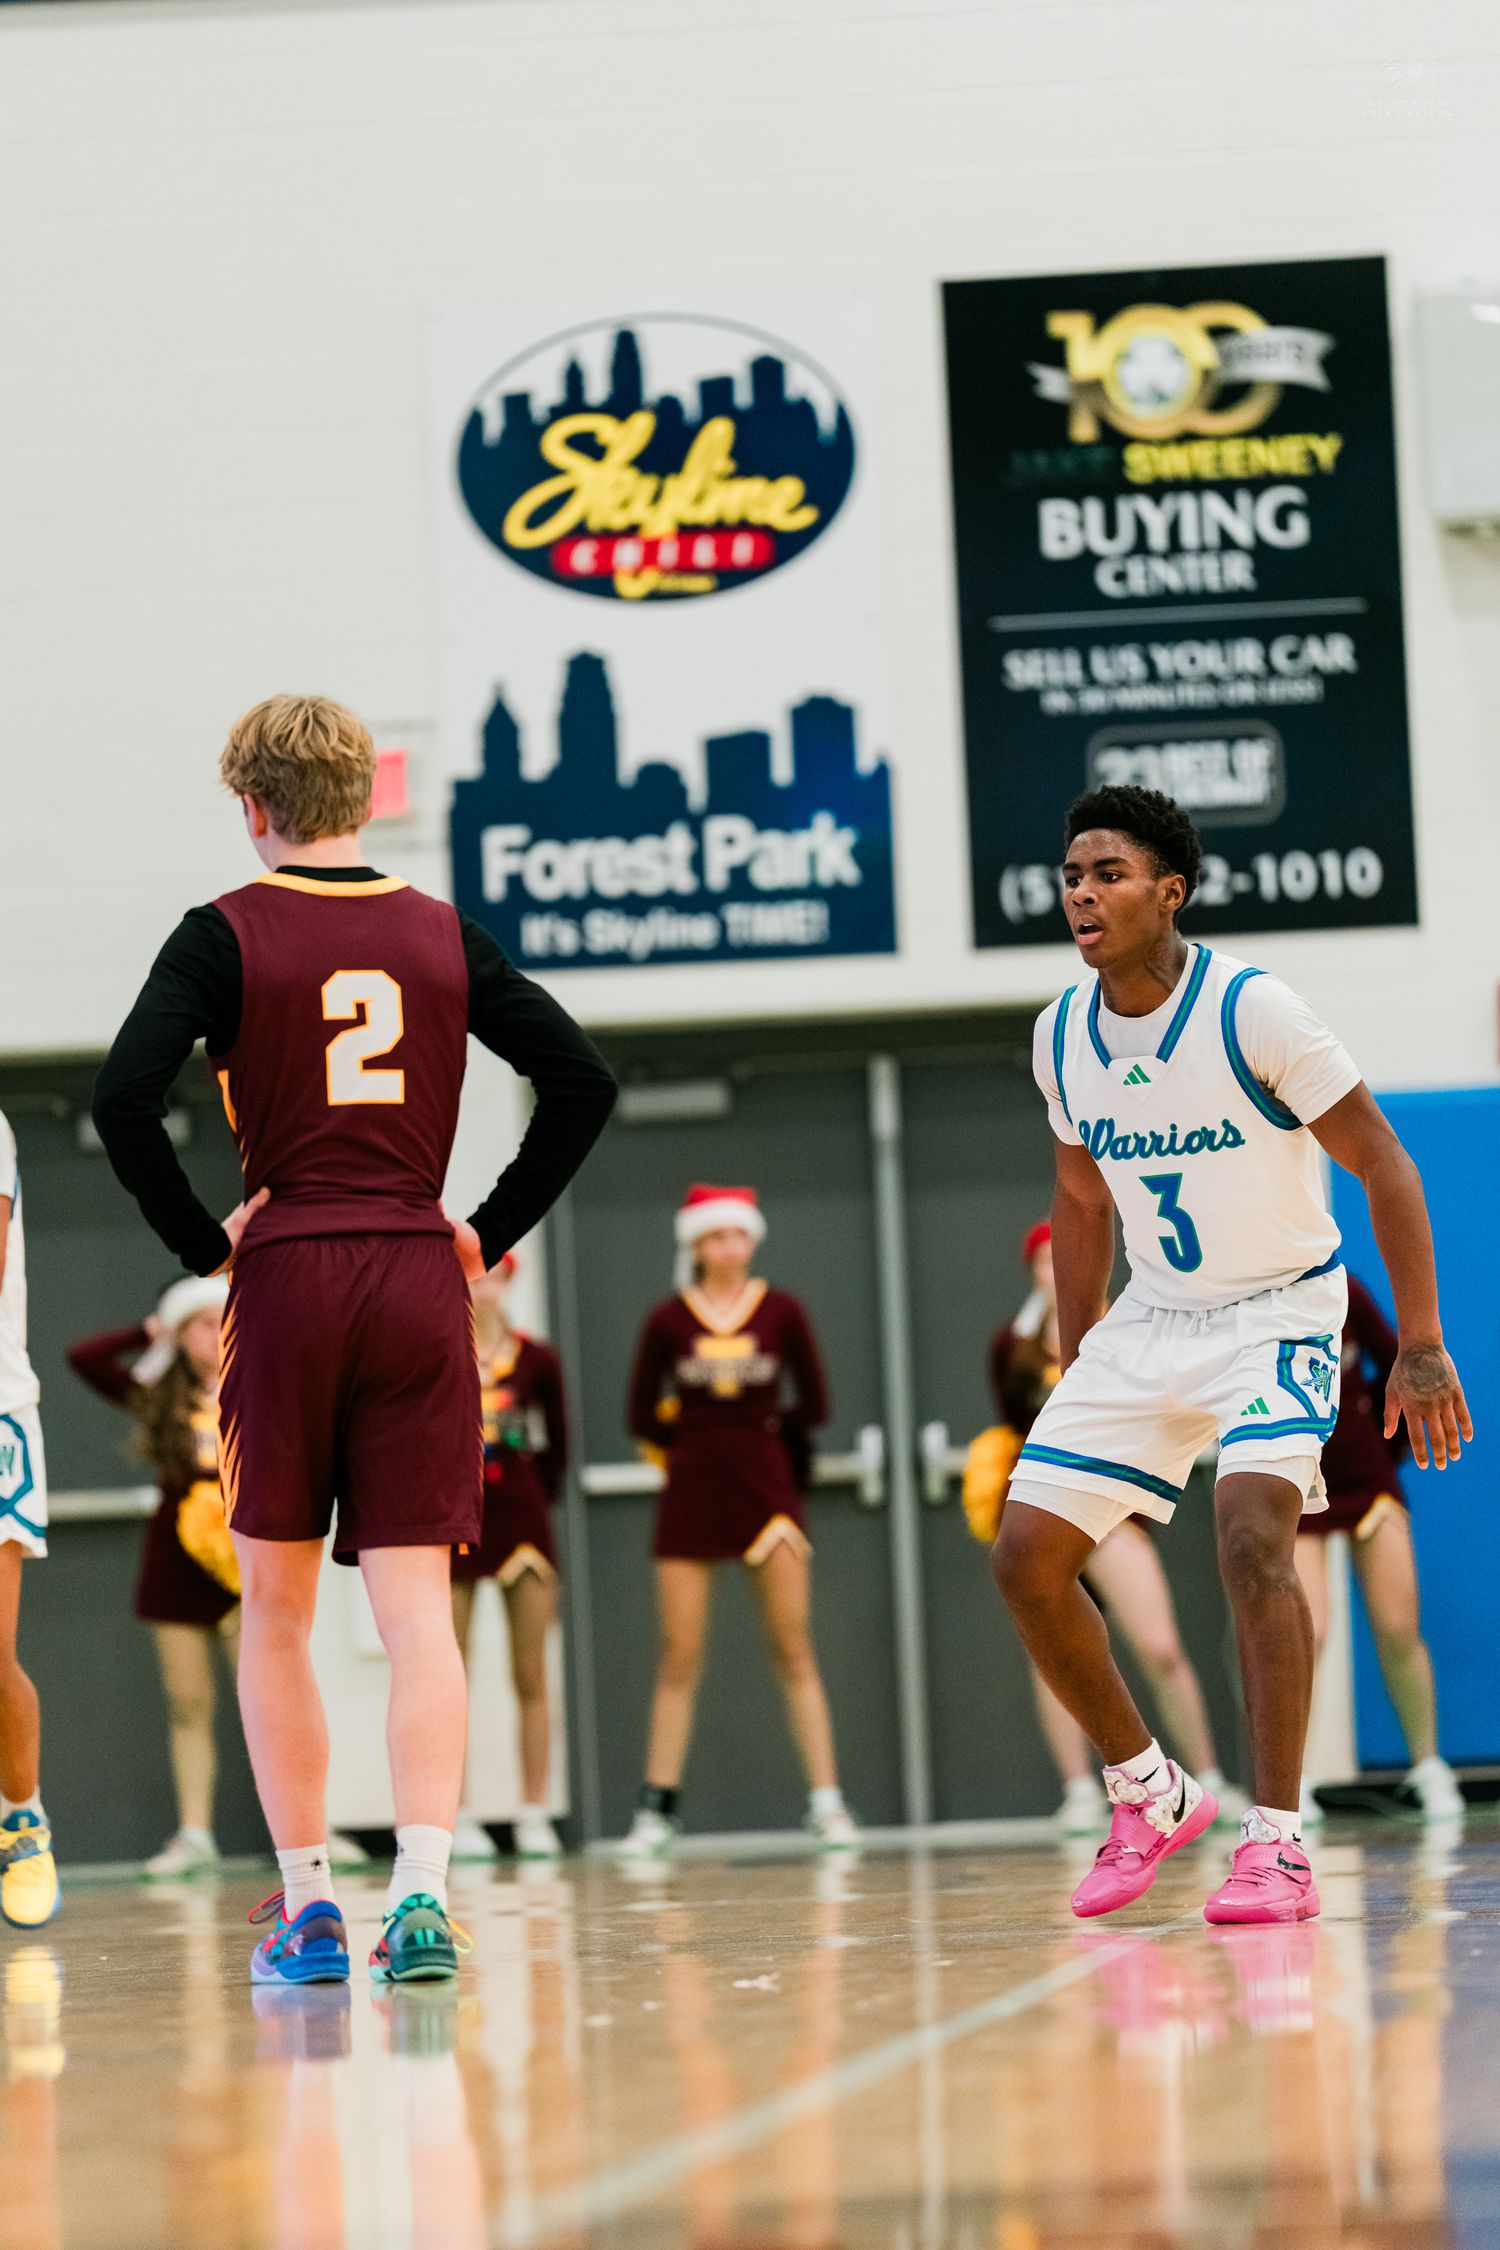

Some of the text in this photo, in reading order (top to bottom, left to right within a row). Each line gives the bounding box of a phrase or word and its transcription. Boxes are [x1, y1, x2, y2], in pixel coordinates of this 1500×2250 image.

[503, 410, 819, 560] Skyline
[1123, 433, 1343, 484] SWEENEY
[1037, 484, 1311, 560] BUYING
[1095, 550, 1257, 598] CENTER
[1002, 632, 1358, 692] SELL US YOUR CAR
[480, 809, 863, 902] Forest Park
[520, 911, 580, 958] It's
[583, 905, 721, 962] Skyline
[321, 969, 405, 1106] 2
[1078, 1119, 1246, 1161] Warriors
[1139, 1172, 1203, 1273] 3
